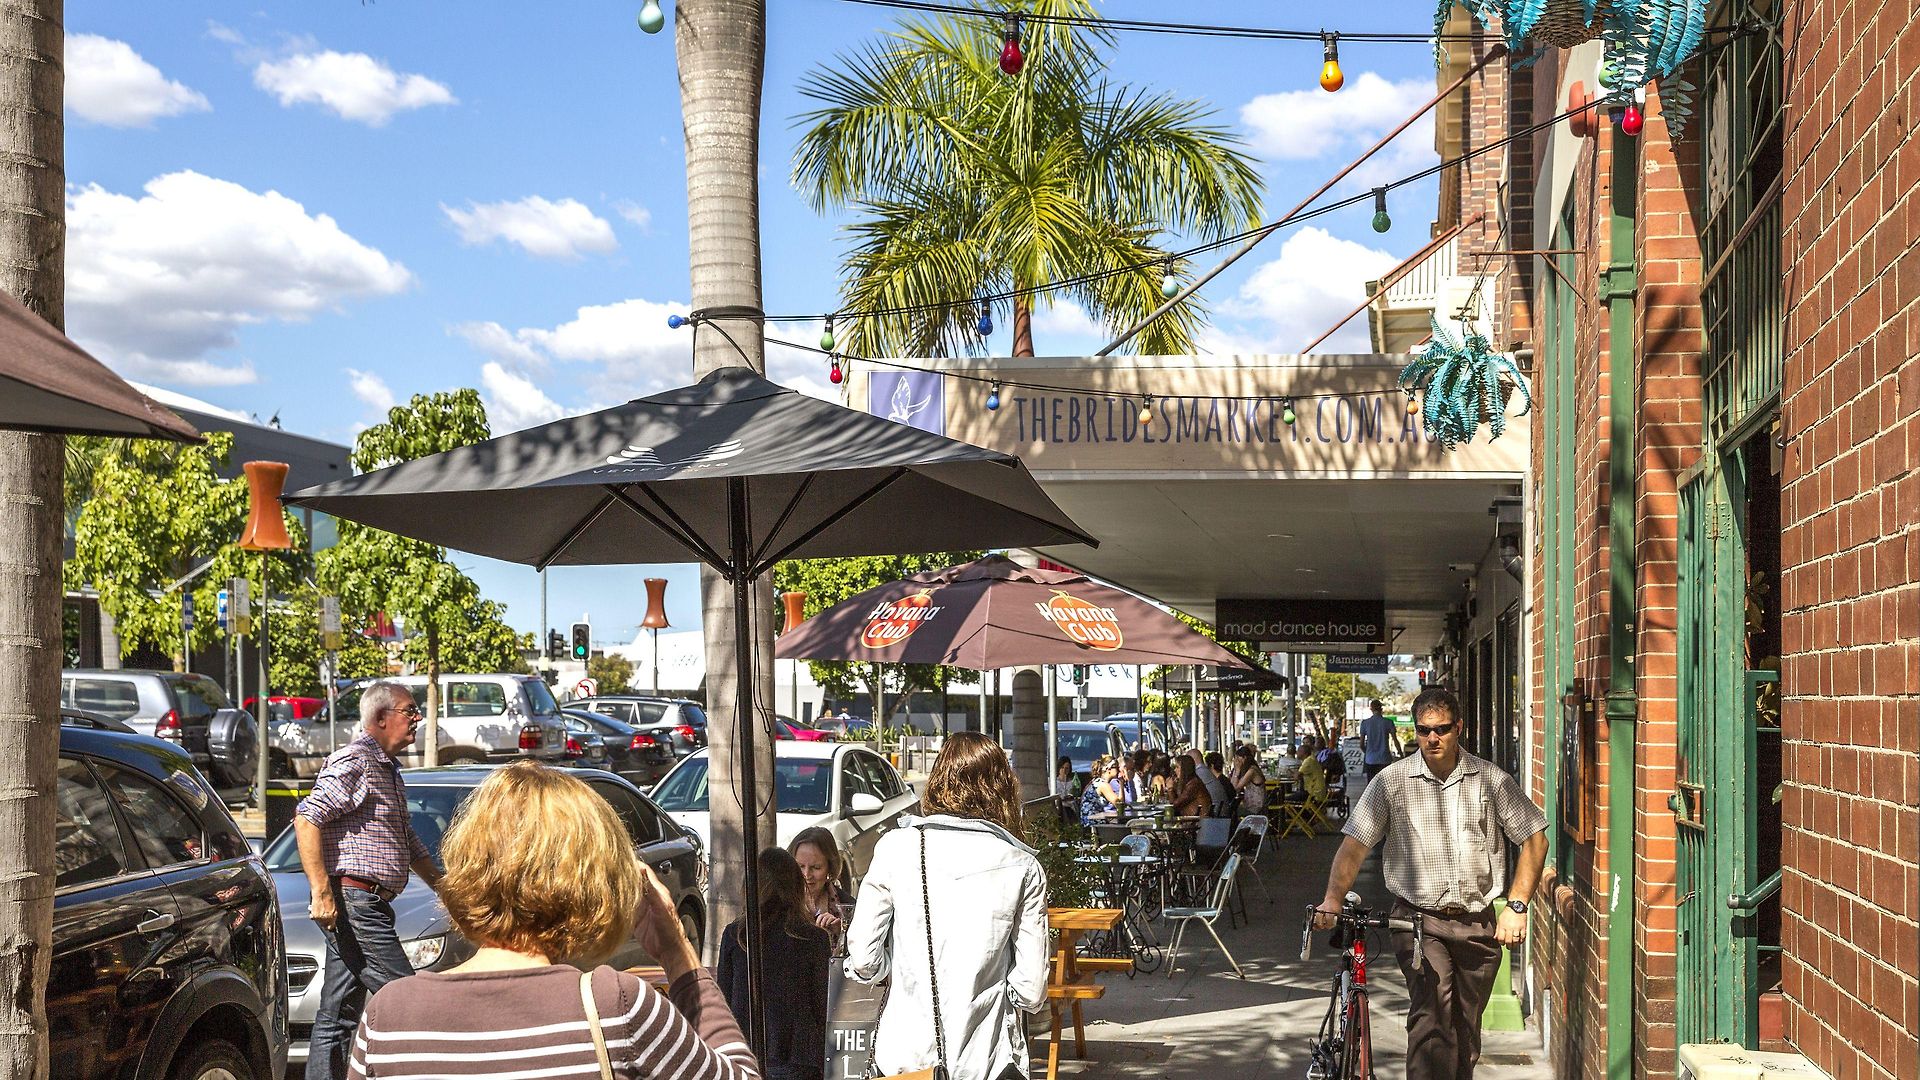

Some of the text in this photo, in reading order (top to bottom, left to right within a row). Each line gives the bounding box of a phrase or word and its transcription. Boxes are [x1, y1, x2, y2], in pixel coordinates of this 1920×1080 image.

[1013, 396, 1439, 443] THEBRIDESMARKET.COM.A
[867, 601, 941, 621] Havana
[1034, 602, 1118, 622] Havana
[867, 622, 910, 638] Club
[1067, 622, 1117, 641] Club
[1224, 620, 1377, 637] mad dance house
[1328, 655, 1386, 665] Jamieson's
[833, 1029, 866, 1051] THE
